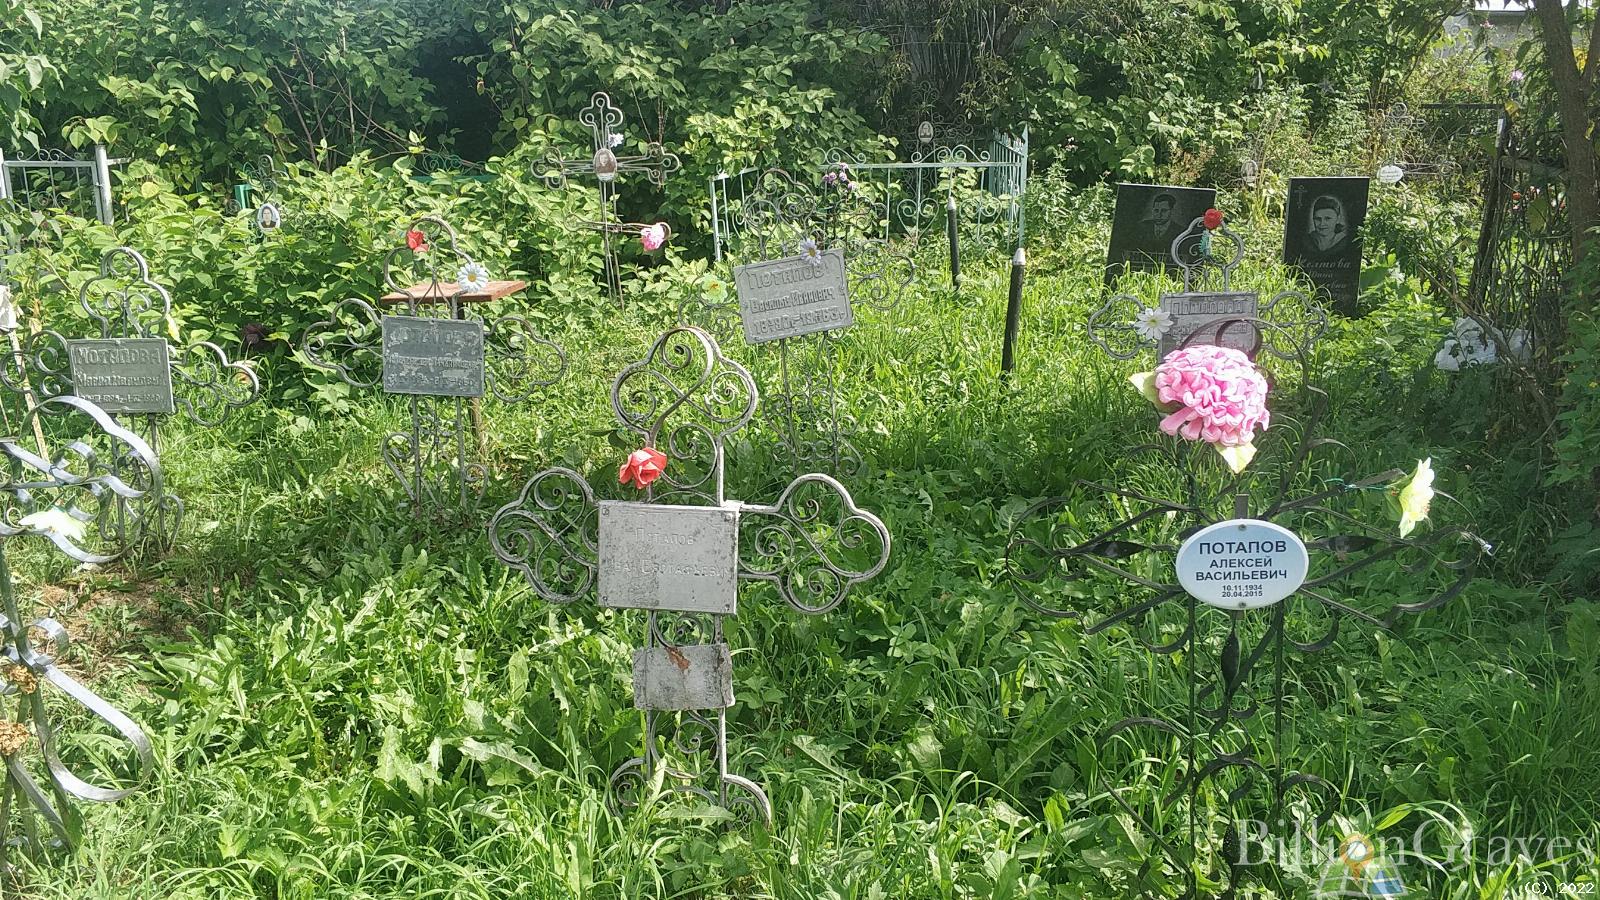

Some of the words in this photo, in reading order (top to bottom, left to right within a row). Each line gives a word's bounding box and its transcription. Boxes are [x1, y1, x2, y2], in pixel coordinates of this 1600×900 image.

[1199, 540, 1287, 555] ПОТАПОВ
[1209, 556, 1273, 569] АЛЕКСЕЙ
[1196, 569, 1287, 581] ВАСИЛЬЕВИЧ
[1222, 584, 1263, 592] 10.11.1934
